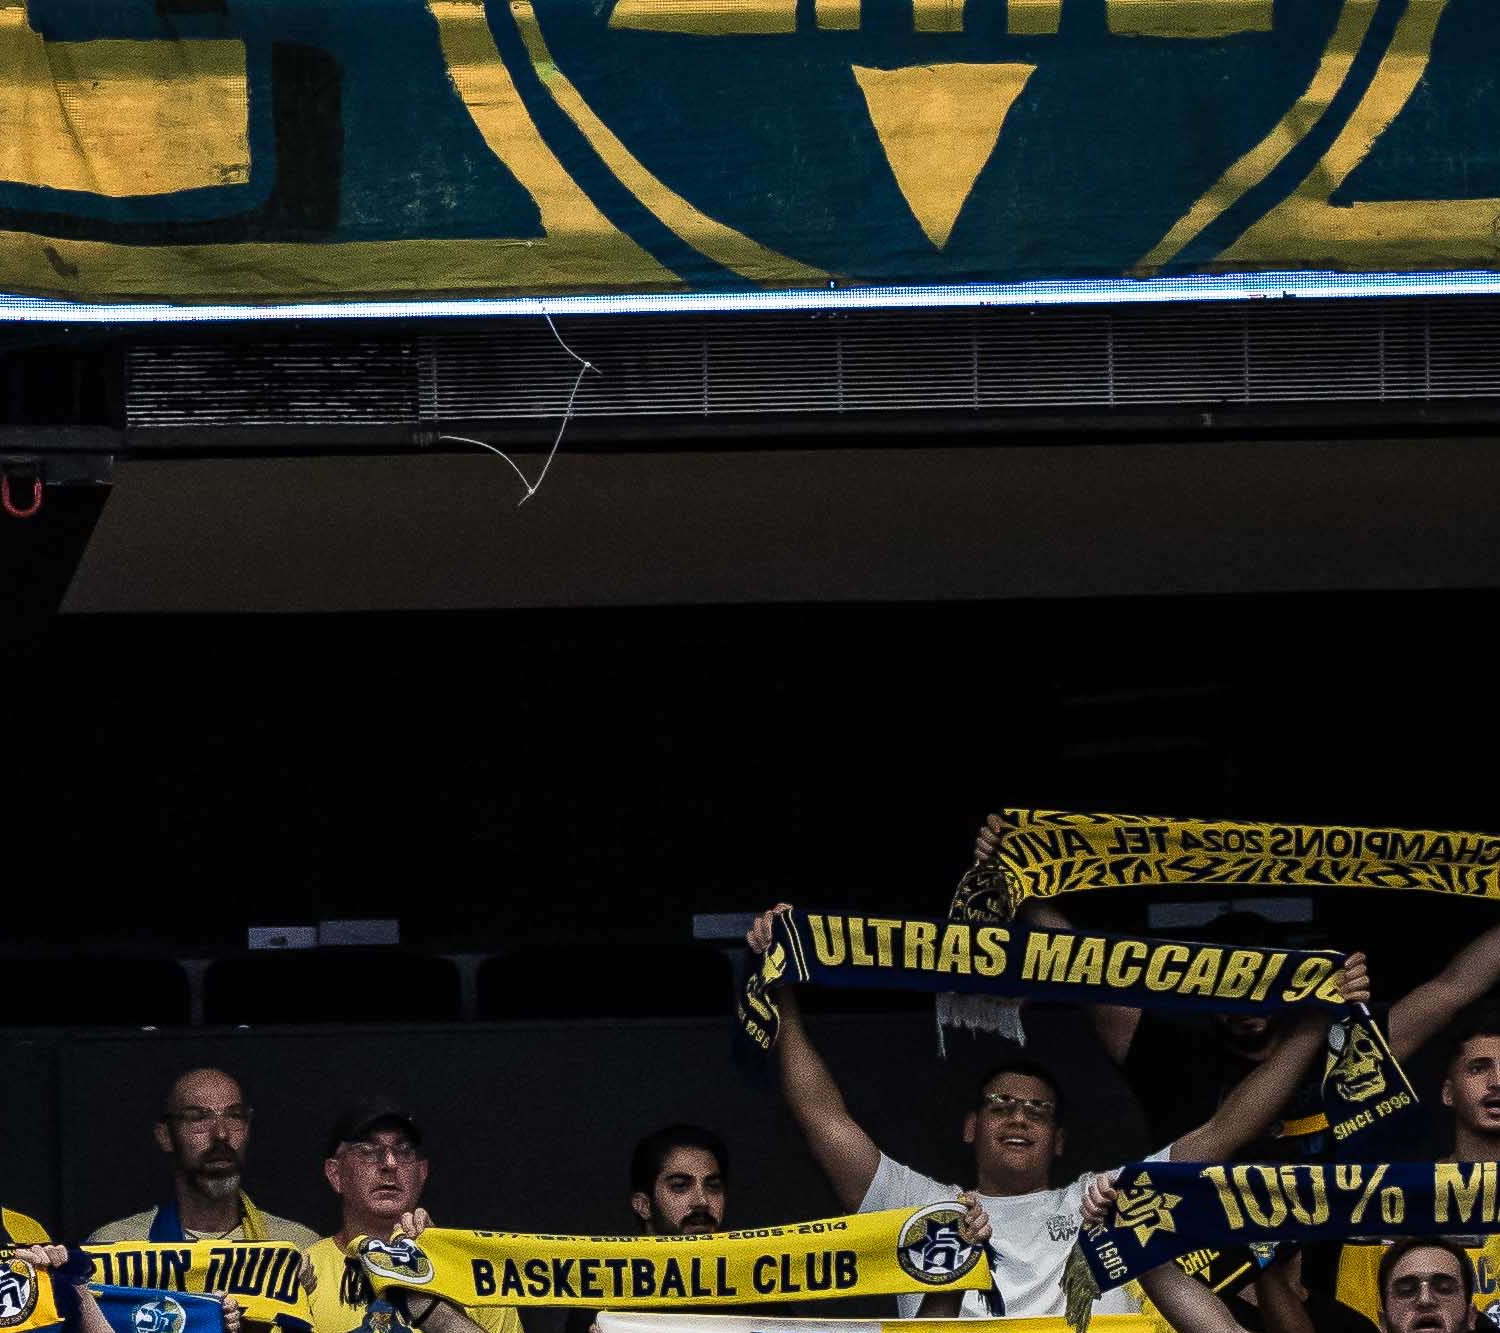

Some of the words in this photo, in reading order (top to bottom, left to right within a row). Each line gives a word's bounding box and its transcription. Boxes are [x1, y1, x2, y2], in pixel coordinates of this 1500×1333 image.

[807, 914, 1011, 977] ULTRAS
[1020, 931, 1288, 1004] MACCABI
[1199, 1162, 1406, 1229] 100%
[470, 1257, 737, 1298] BASKETBALL
[751, 1249, 860, 1296] CLUB
